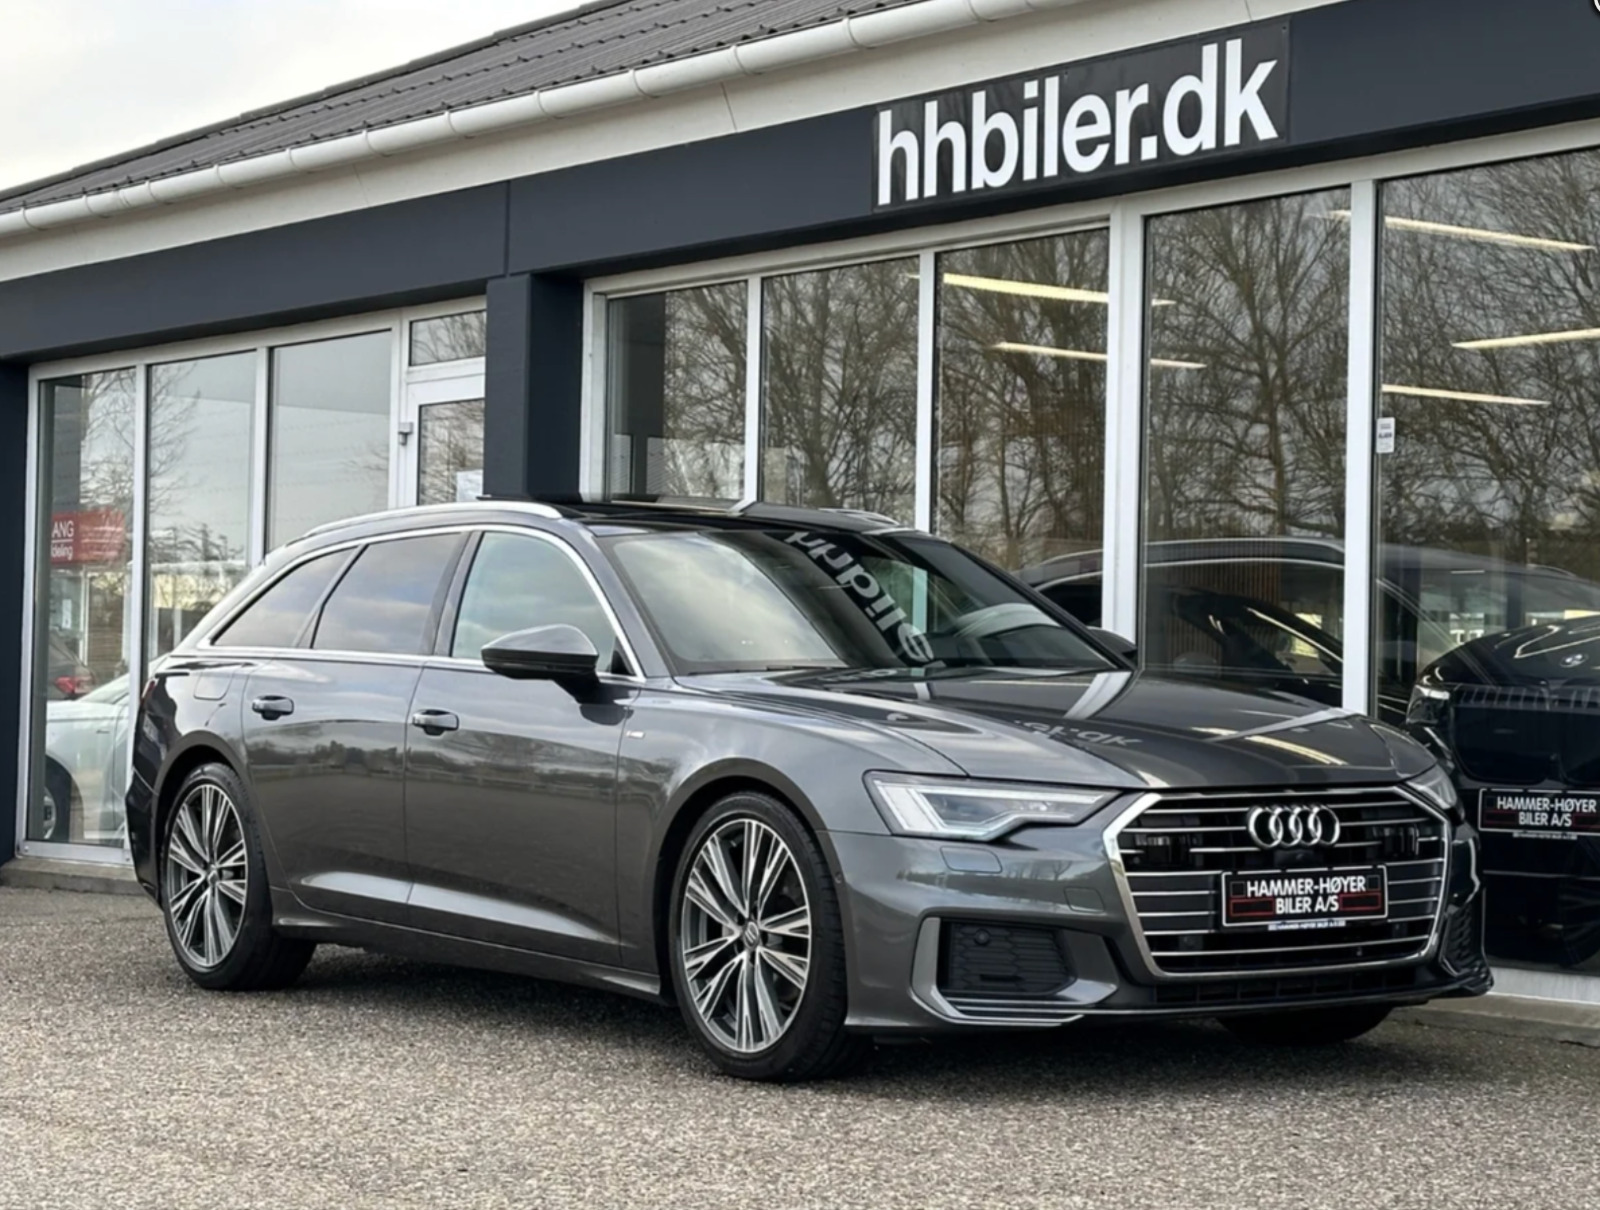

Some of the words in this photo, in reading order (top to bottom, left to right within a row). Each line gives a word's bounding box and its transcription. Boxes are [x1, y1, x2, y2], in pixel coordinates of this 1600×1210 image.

[878, 38, 1279, 206] hhbiler.dk
[1496, 796, 1597, 813] HAMMER-HØYER
[1518, 811, 1548, 826] BILER
[1550, 812, 1573, 827] A/S
[1246, 875, 1366, 898] HAMMER-HØYER
[1275, 896, 1312, 914] BILER
[1314, 894, 1340, 912] A/S
